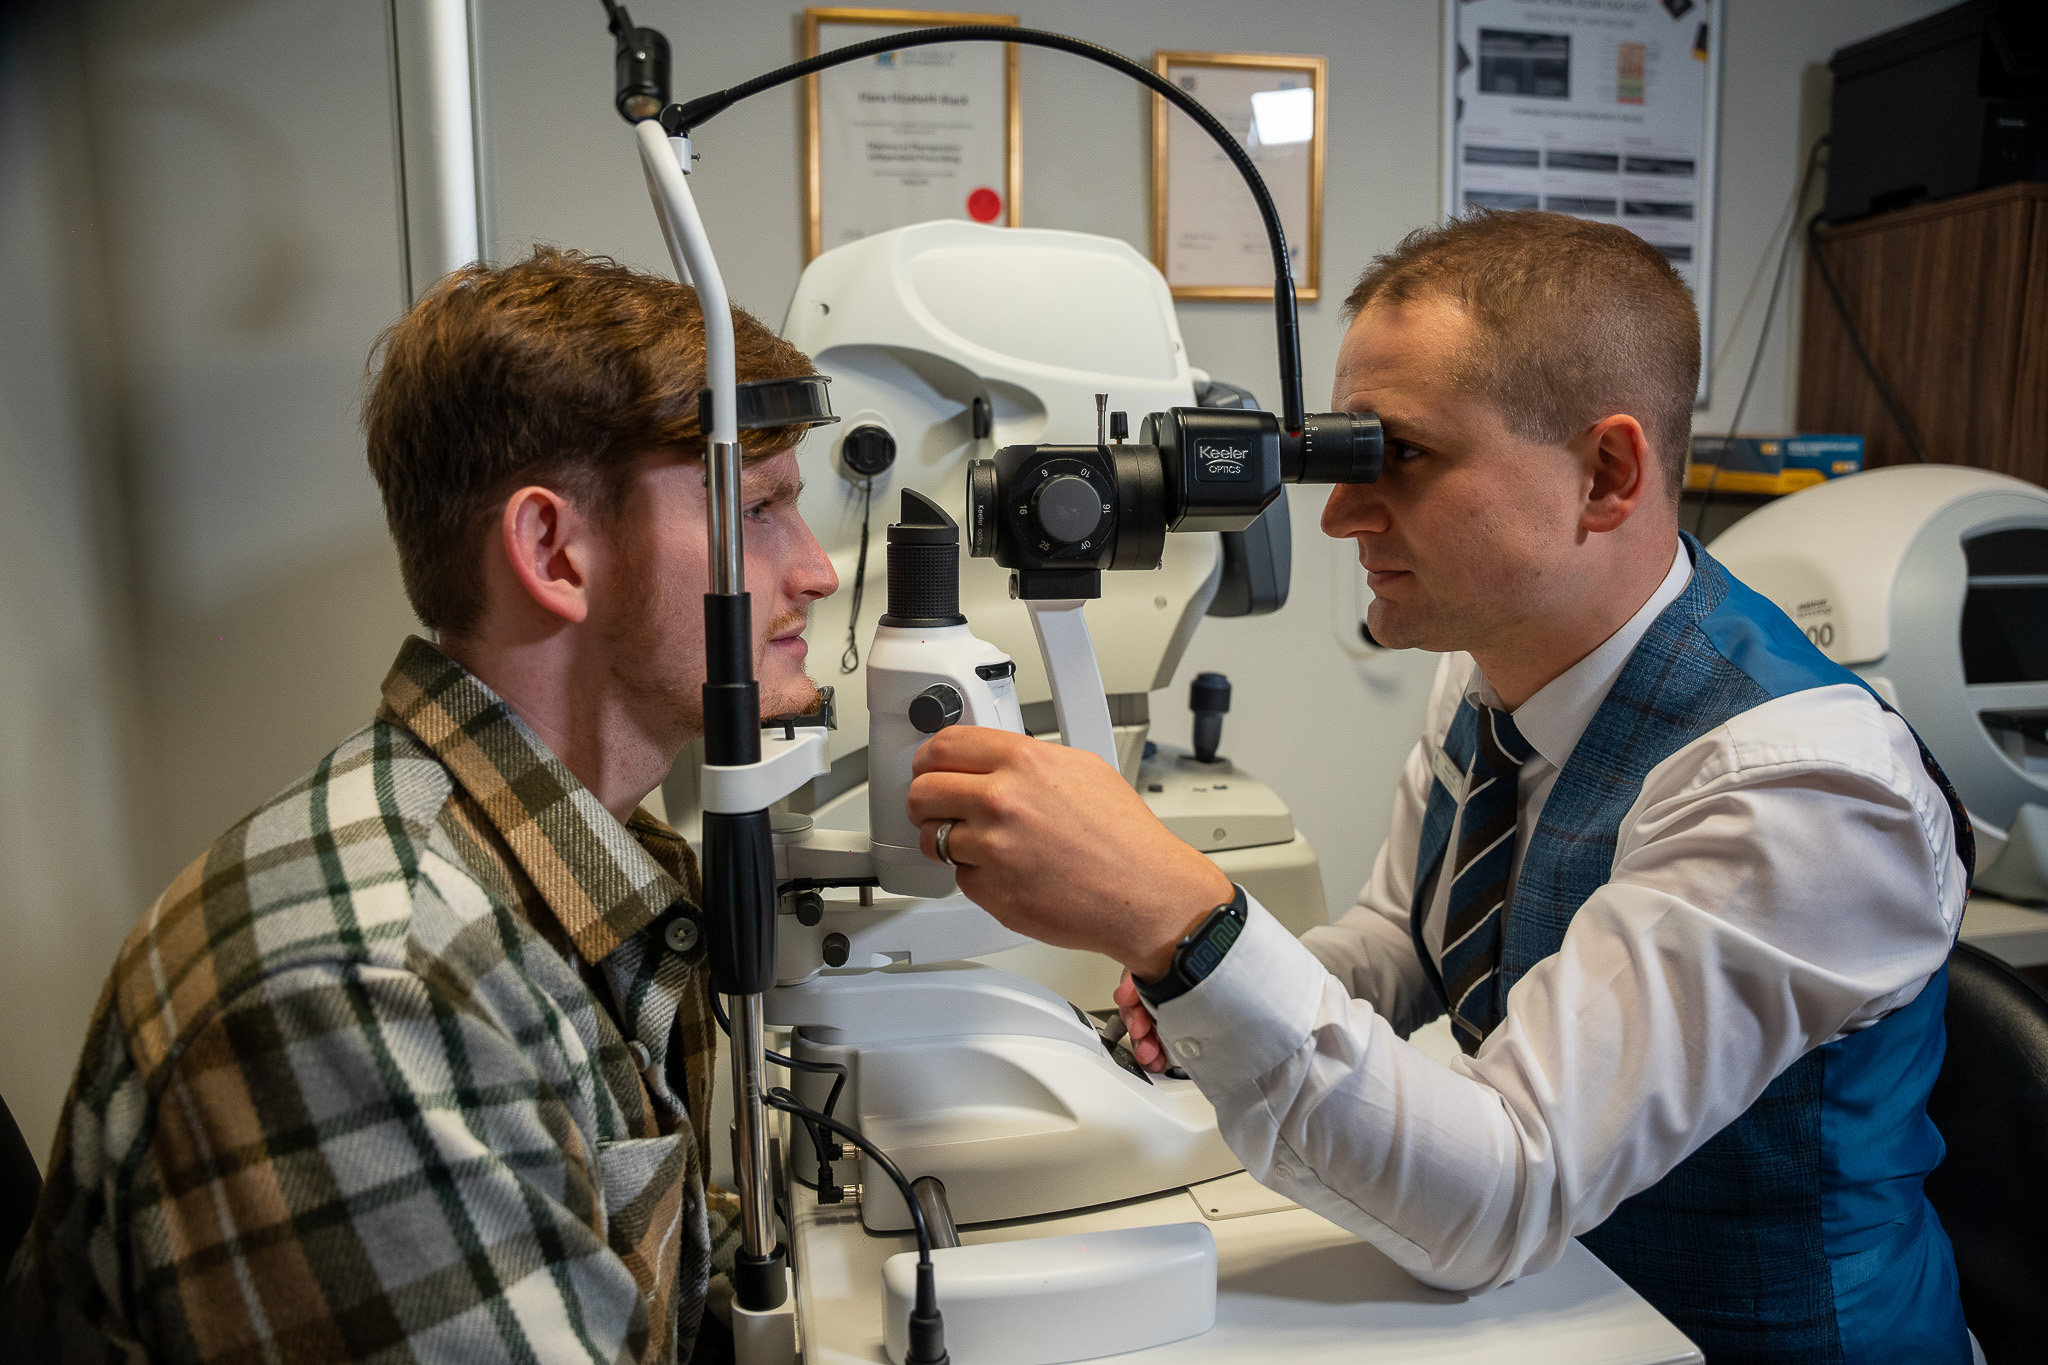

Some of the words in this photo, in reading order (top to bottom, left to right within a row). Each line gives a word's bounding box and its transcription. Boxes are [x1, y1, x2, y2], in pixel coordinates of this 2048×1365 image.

[1199, 445, 1249, 459] Keeler
[1080, 467, 1091, 478] 10
[1208, 465, 1241, 474] OPTICS
[1019, 504, 1028, 515] 16
[1102, 503, 1111, 514] 16
[977, 504, 985, 526] Keeler
[1038, 540, 1051, 551] 25
[1081, 540, 1091, 550] 40
